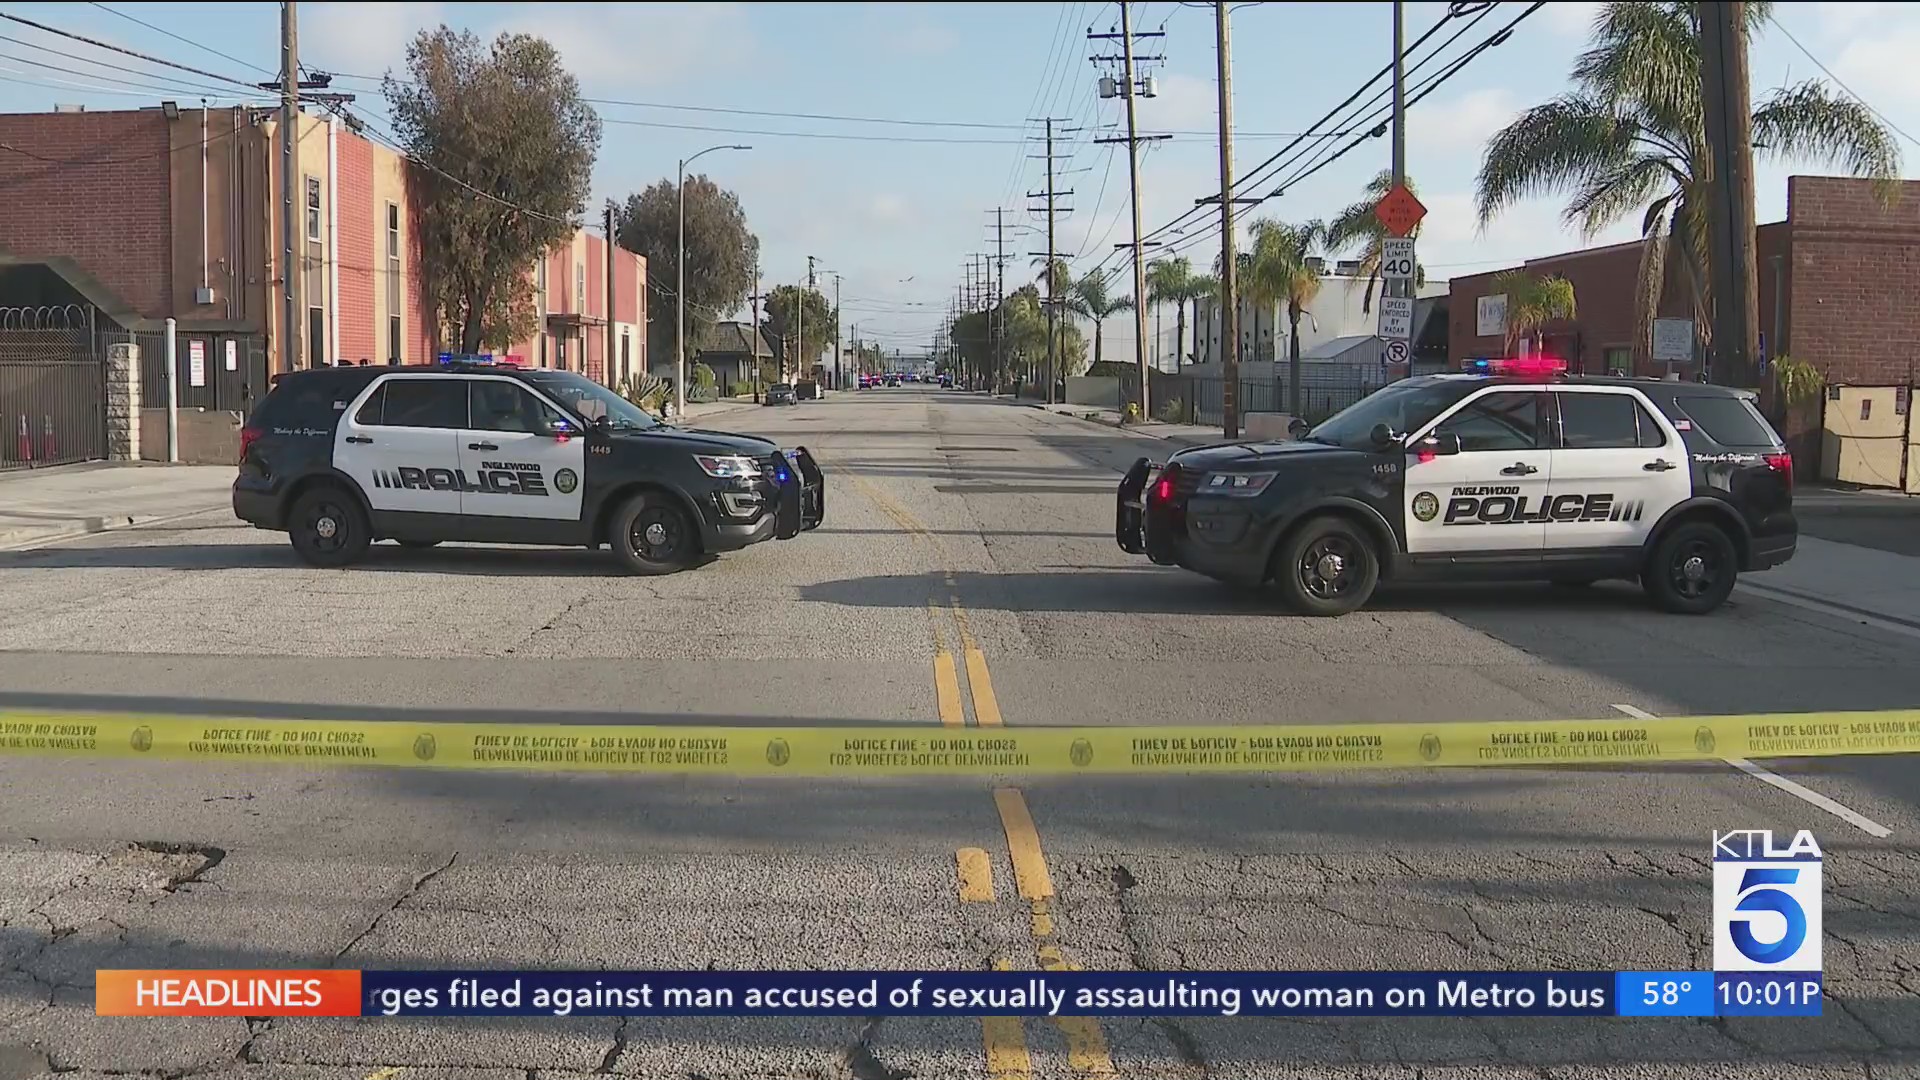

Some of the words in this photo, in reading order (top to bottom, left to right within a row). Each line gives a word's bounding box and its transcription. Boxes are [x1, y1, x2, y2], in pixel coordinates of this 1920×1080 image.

[1384, 241, 1411, 249] SPEED
[1387, 250, 1408, 258] LIMIT
[1384, 259, 1411, 275] 40
[1387, 301, 1406, 309] SPEED
[1381, 309, 1410, 318] ENFORCED
[1384, 326, 1405, 334] RADAR
[1718, 453, 1726, 461] the
[482, 461, 541, 471] INGLEWOOD
[398, 466, 549, 496] POLICE
[1451, 486, 1520, 496] INGLEWOOD
[1443, 494, 1614, 525] POLICE
